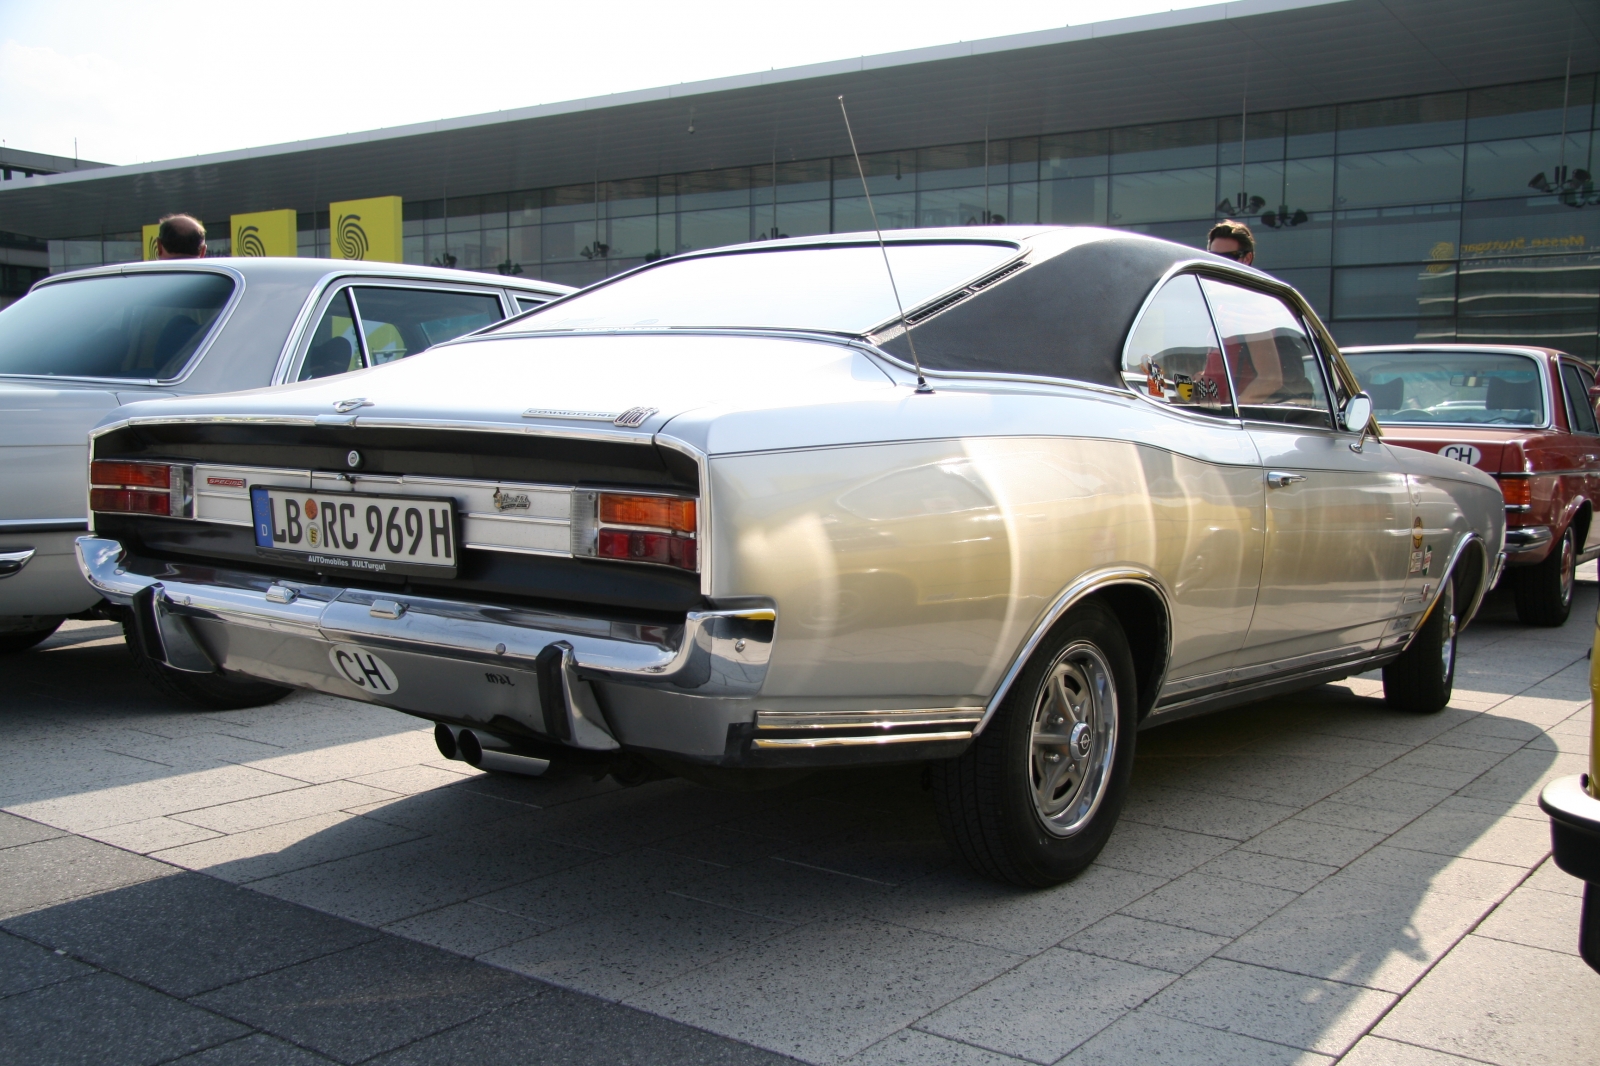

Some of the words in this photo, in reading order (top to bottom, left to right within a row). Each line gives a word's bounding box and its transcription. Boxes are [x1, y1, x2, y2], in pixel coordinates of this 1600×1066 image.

[1445, 446, 1472, 465] CH
[261, 524, 268, 536] D
[269, 497, 303, 544] LB
[320, 501, 359, 550] RC
[308, 555, 349, 567] AUTOmobiles
[351, 560, 387, 571] KULTurgut
[336, 650, 392, 691] CH
